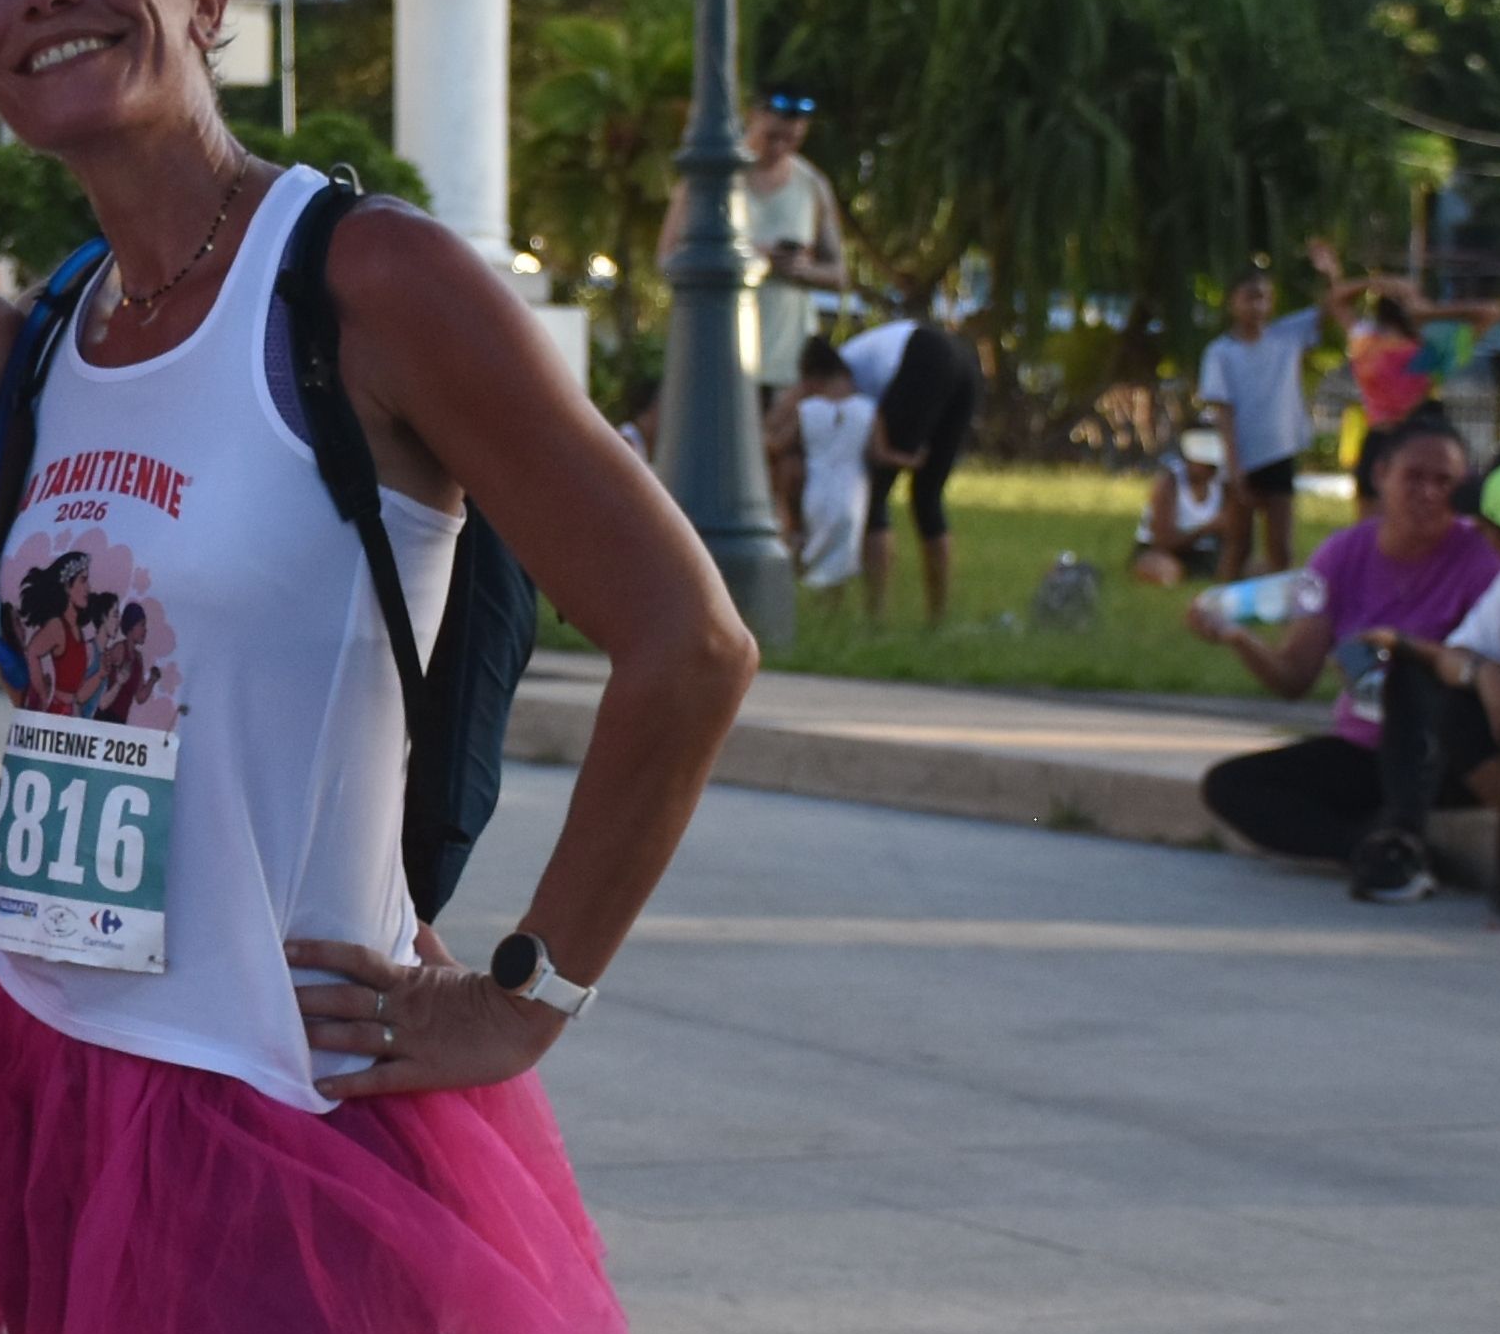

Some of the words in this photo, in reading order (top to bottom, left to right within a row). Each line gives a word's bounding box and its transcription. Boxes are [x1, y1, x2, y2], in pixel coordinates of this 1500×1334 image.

[35, 450, 185, 519] TAHITIENNE
[54, 500, 109, 522] 2026
[13, 724, 99, 760] TAHITIENNE
[102, 738, 148, 767] 2026
